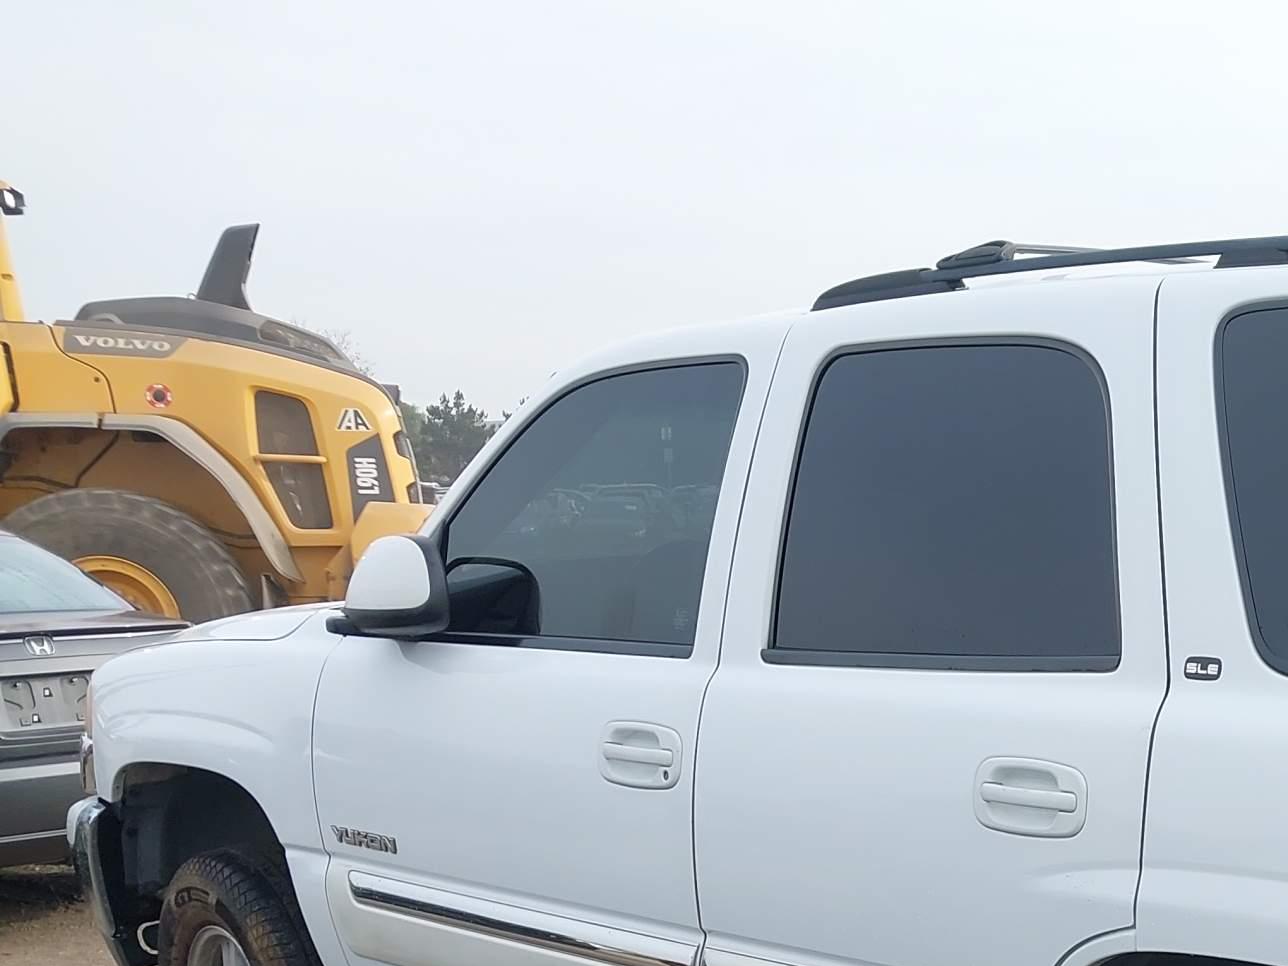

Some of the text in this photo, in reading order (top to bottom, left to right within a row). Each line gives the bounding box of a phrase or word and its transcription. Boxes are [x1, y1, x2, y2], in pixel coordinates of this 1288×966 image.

[72, 334, 171, 352] VOLVO
[353, 456, 381, 495] L90H
[1185, 662, 1219, 675] SLE
[330, 825, 398, 855] YUKON
